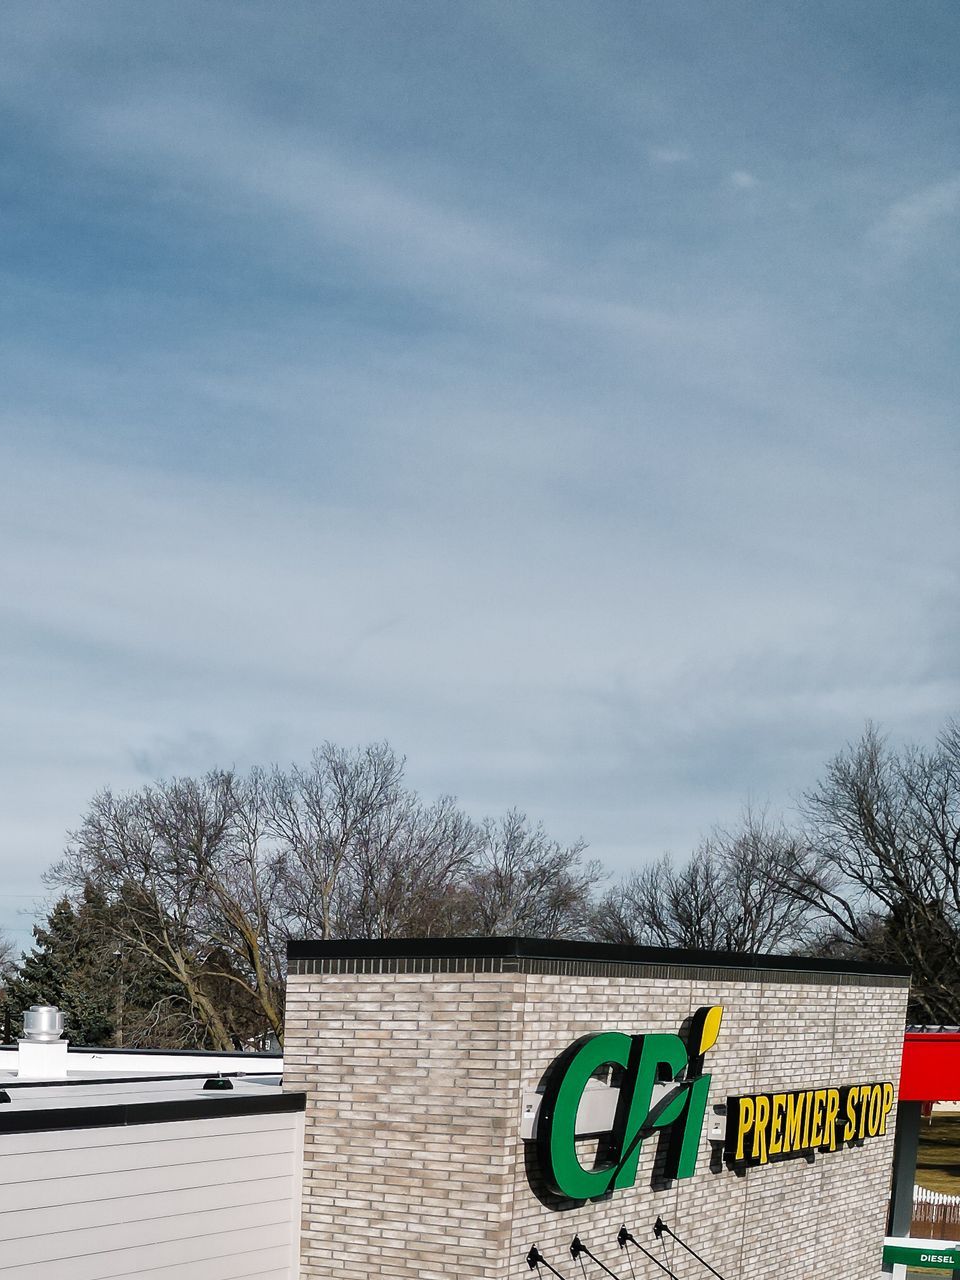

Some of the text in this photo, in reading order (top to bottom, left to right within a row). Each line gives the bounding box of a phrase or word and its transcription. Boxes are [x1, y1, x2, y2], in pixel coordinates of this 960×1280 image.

[735, 1082, 894, 1165] PREMIER STOP
[920, 1254, 955, 1264] DIESEL
